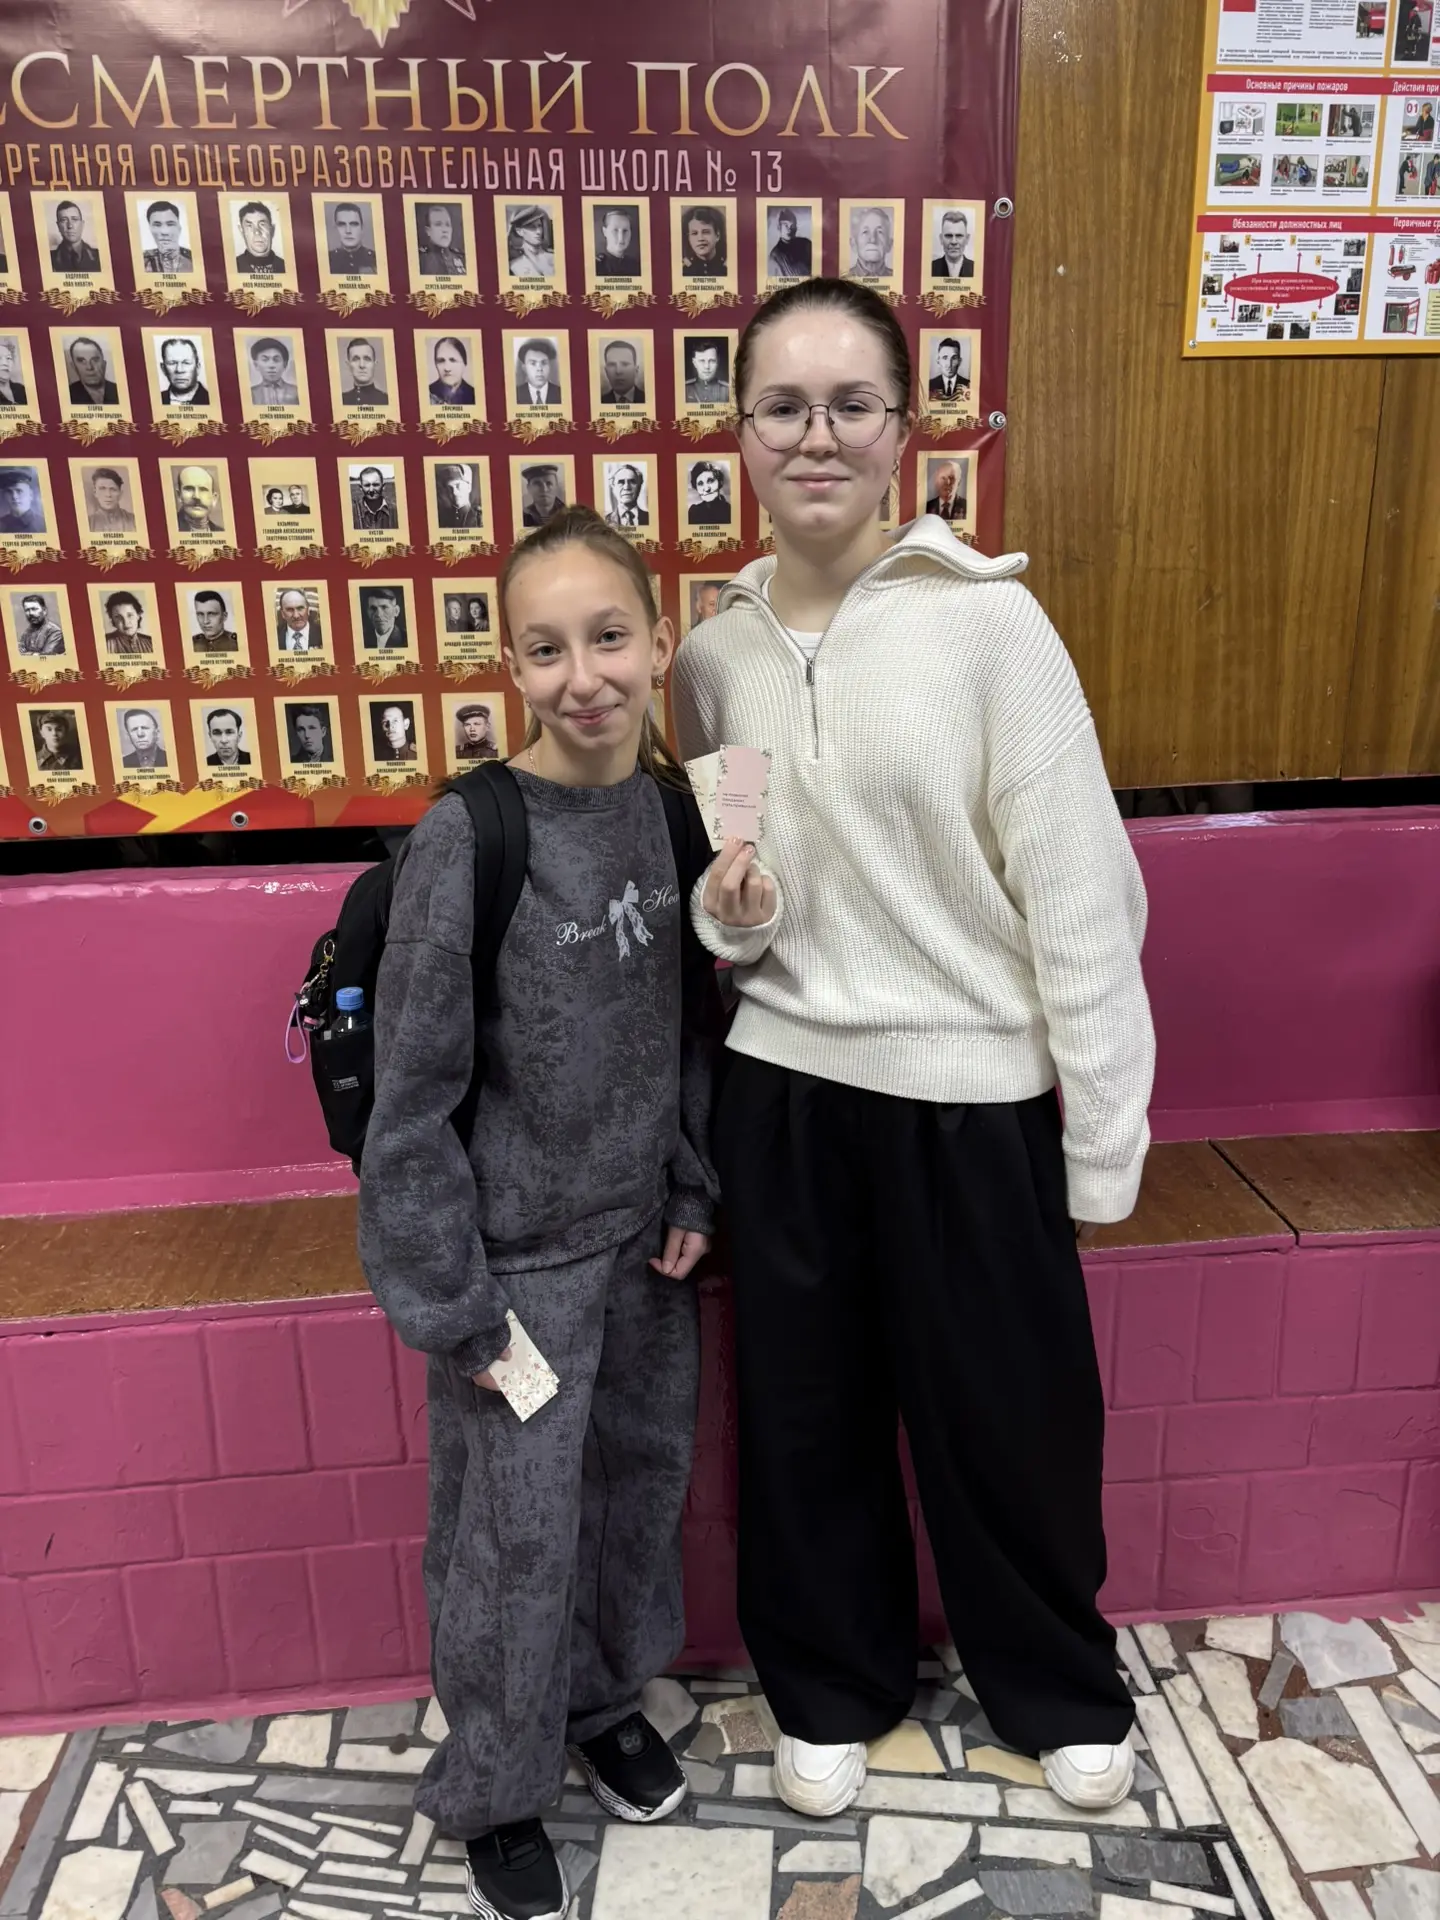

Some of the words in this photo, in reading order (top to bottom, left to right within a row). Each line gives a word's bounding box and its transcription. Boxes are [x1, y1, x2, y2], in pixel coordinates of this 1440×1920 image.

[1246, 78, 1282, 90] Основные
[1284, 80, 1315, 92] причины
[1317, 81, 1348, 92] пожаров
[1392, 81, 1425, 93] Действия
[1426, 83, 1440, 94] при
[0, 50, 594, 134] СМЕРТНЫЙ
[628, 61, 909, 140] ПОЛК
[1406, 102, 1420, 113] 01
[151, 144, 565, 192] ОБЩЕОБРАЗОВАТЕЛЬНАЯ
[580, 148, 693, 192] ШКОЛА
[706, 149, 737, 193] №
[751, 150, 783, 193] 13
[1232, 218, 1277, 229] Обязанности
[1279, 220, 1327, 230] должностных
[1329, 221, 1342, 231] лиц
[1393, 217, 1432, 230] Первичные
[555, 914, 607, 946] Break
